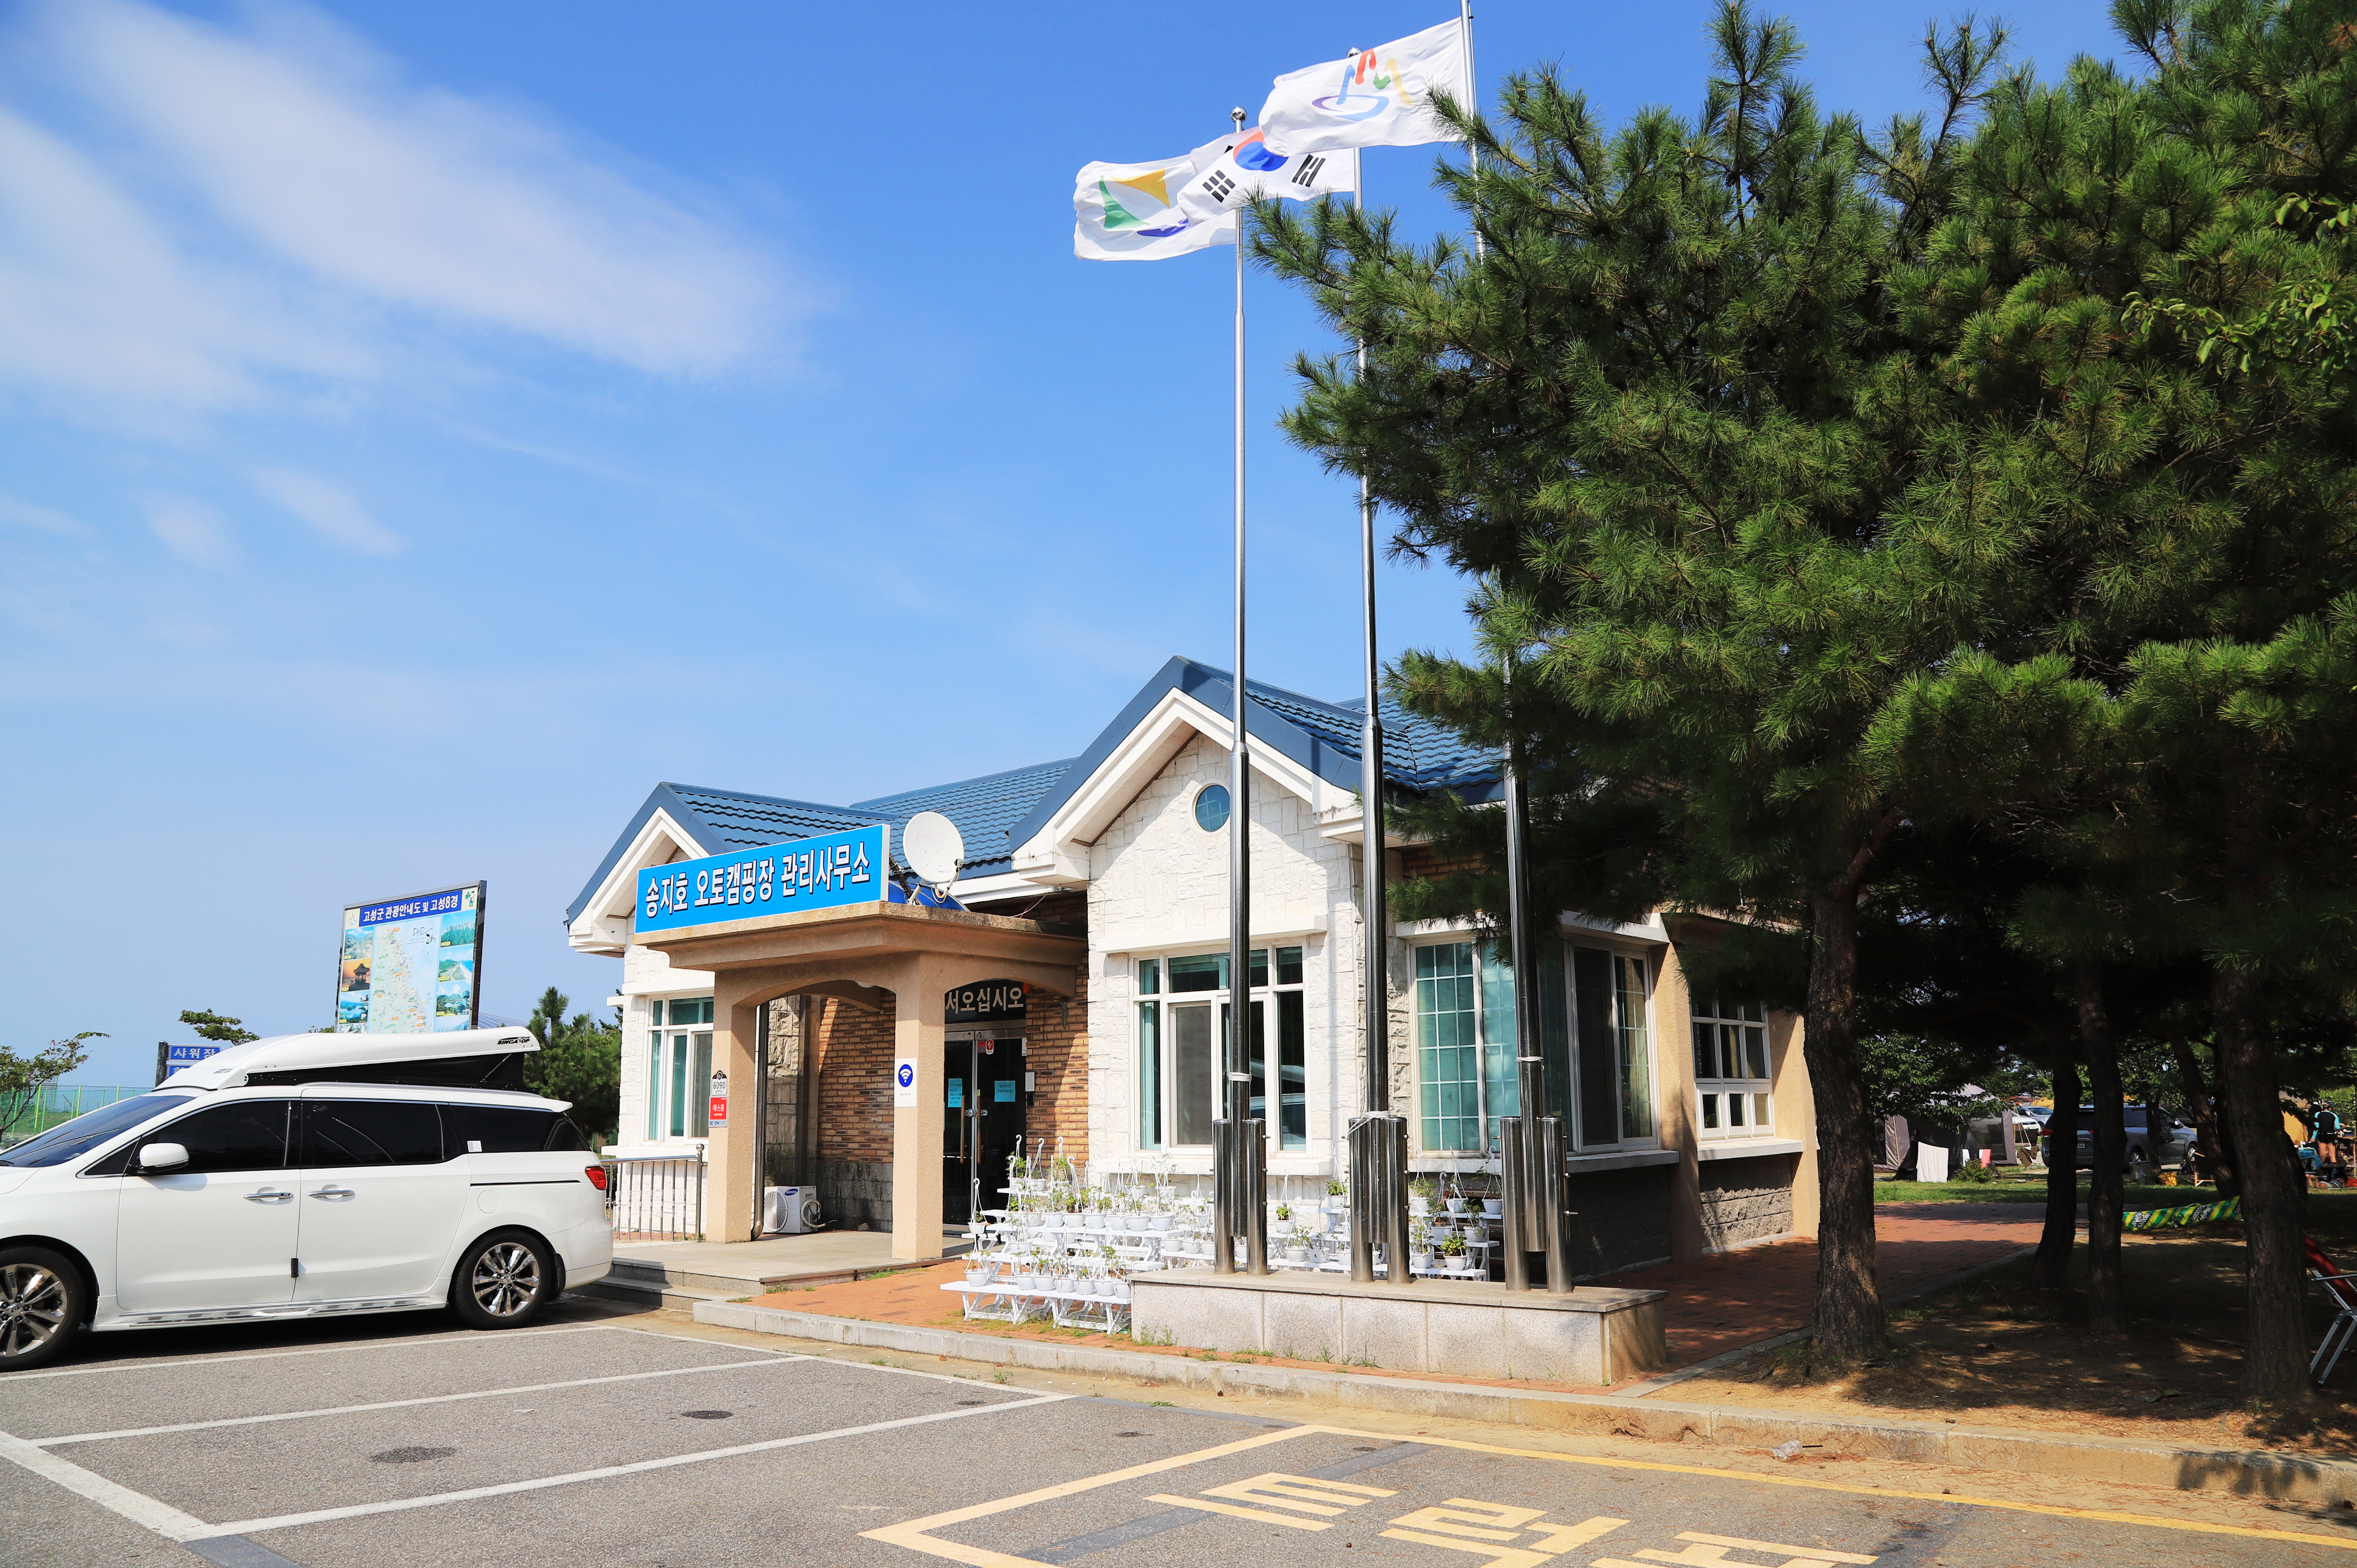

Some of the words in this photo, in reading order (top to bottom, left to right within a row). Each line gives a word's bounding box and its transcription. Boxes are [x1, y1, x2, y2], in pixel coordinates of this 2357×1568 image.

[646, 871, 688, 918] 송지호
[694, 856, 775, 906] 오토캠핑장
[781, 842, 870, 897] 관리사무소
[363, 907, 384, 922] 고성군
[385, 902, 421, 919] 관광안내도
[422, 901, 429, 913] 및
[429, 894, 458, 911] 고성8경
[946, 986, 1024, 1014] 서오십시오
[173, 1047, 216, 1059] 샤워장
